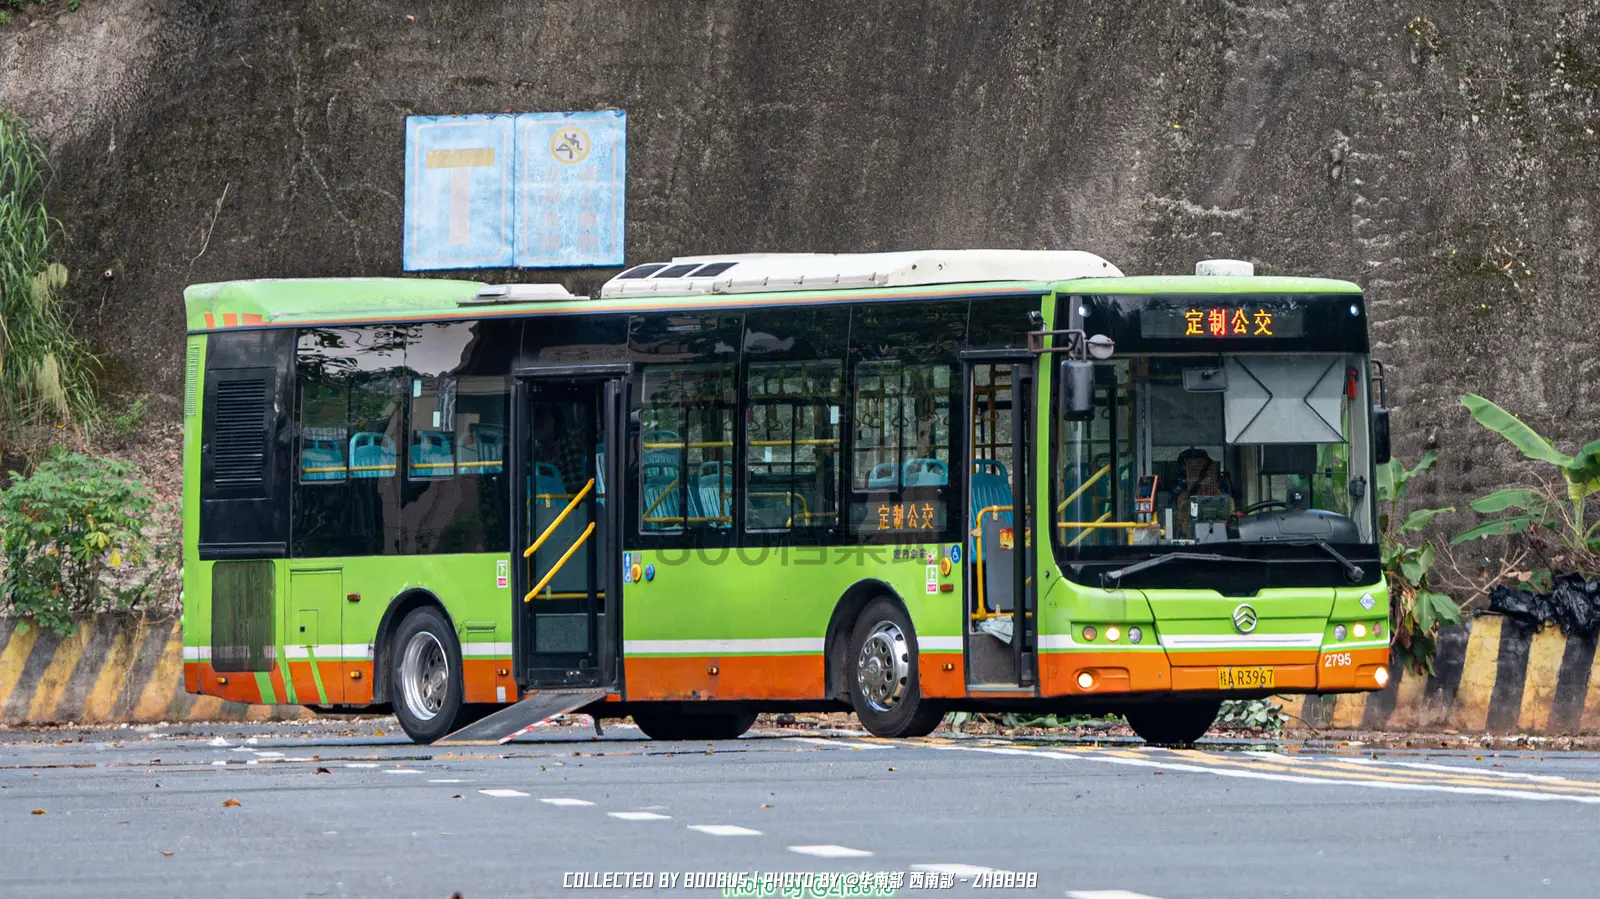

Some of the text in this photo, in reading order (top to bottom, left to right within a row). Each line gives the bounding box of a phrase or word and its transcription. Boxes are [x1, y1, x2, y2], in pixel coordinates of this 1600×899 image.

[1184, 308, 1273, 336] 定制公交
[877, 503, 935, 531] 定制公交
[1324, 653, 1352, 668] 2795
